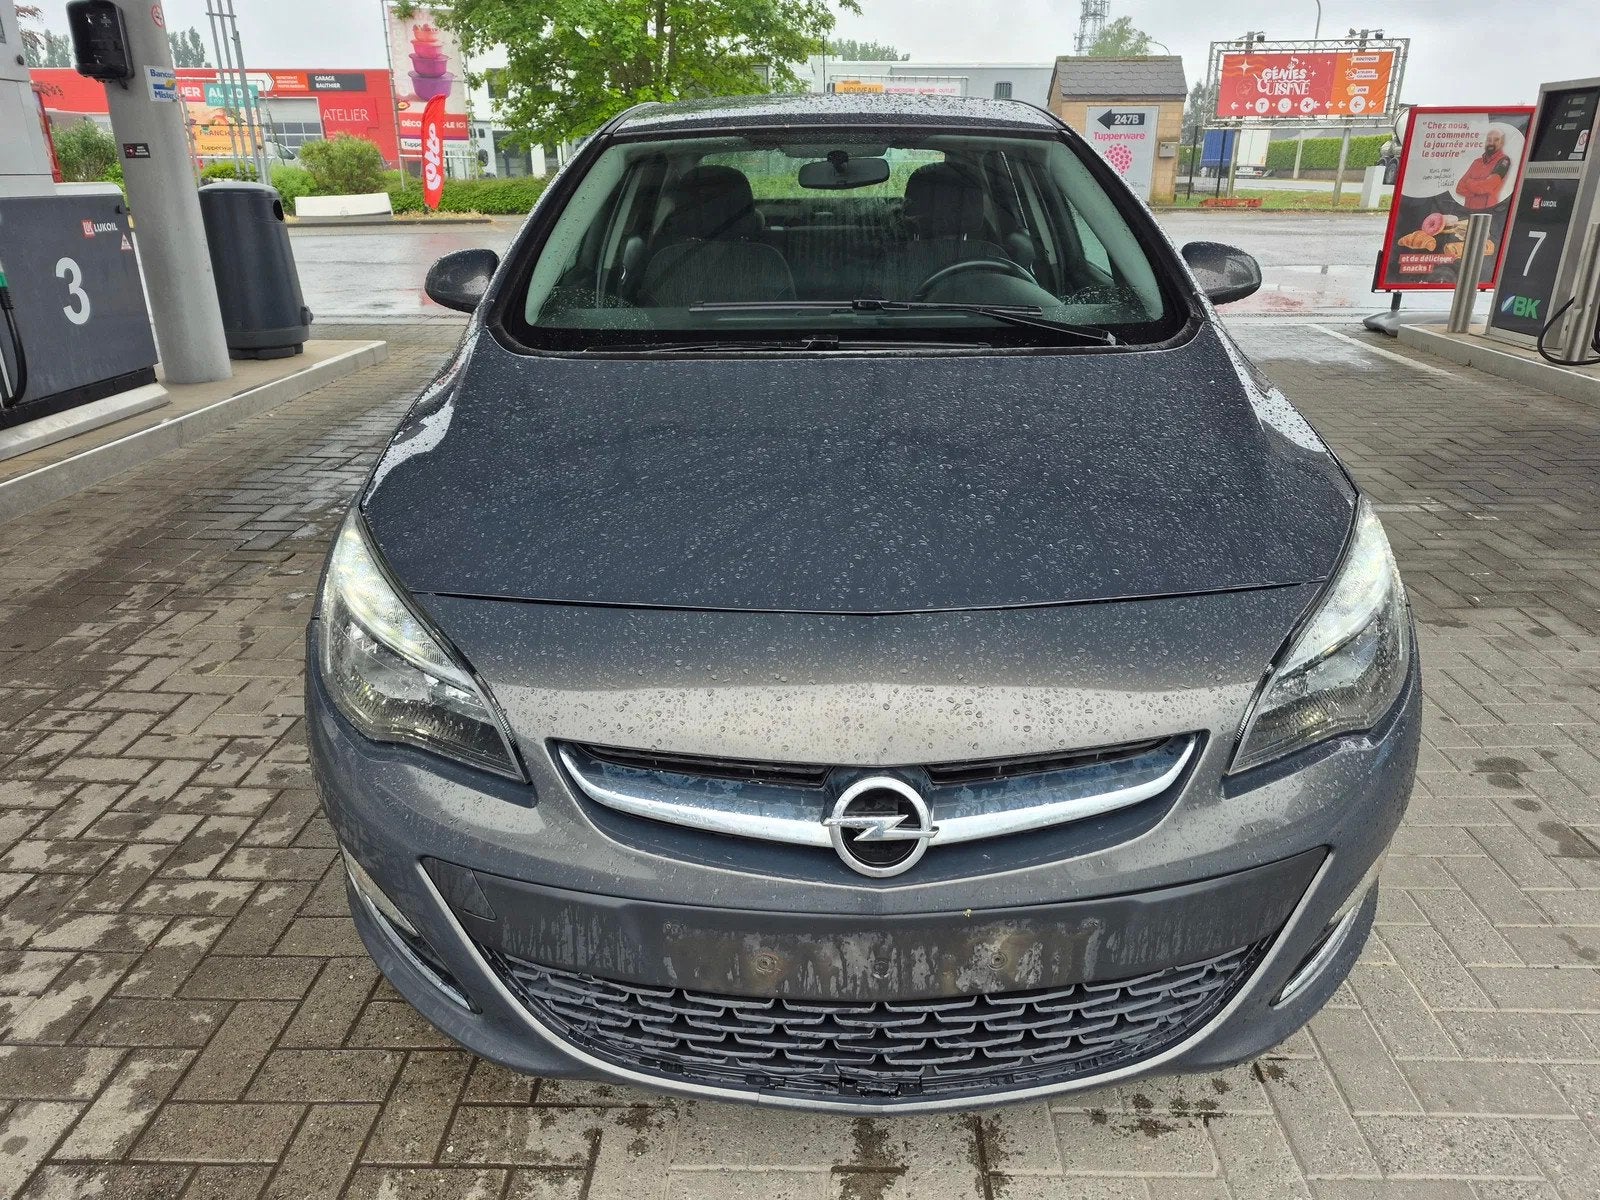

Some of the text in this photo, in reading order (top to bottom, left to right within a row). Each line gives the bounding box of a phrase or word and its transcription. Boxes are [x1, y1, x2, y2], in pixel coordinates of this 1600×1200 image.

[1261, 65, 1307, 80] GÉNIES
[1256, 79, 1311, 95] CUISINE
[322, 108, 370, 121] ATELIER
[1114, 114, 1139, 124] 247B
[1448, 122, 1470, 130] nous,
[1093, 131, 1146, 141] Tupperware
[1432, 140, 1464, 149] journée
[1421, 150, 1430, 158] le
[1541, 200, 1557, 208] LUKOIL
[93, 222, 118, 233] LUKOIL
[1523, 230, 1547, 277] 7
[1402, 264, 1428, 272] snacks
[55, 256, 91, 325] 3
[1513, 296, 1541, 320] BK
